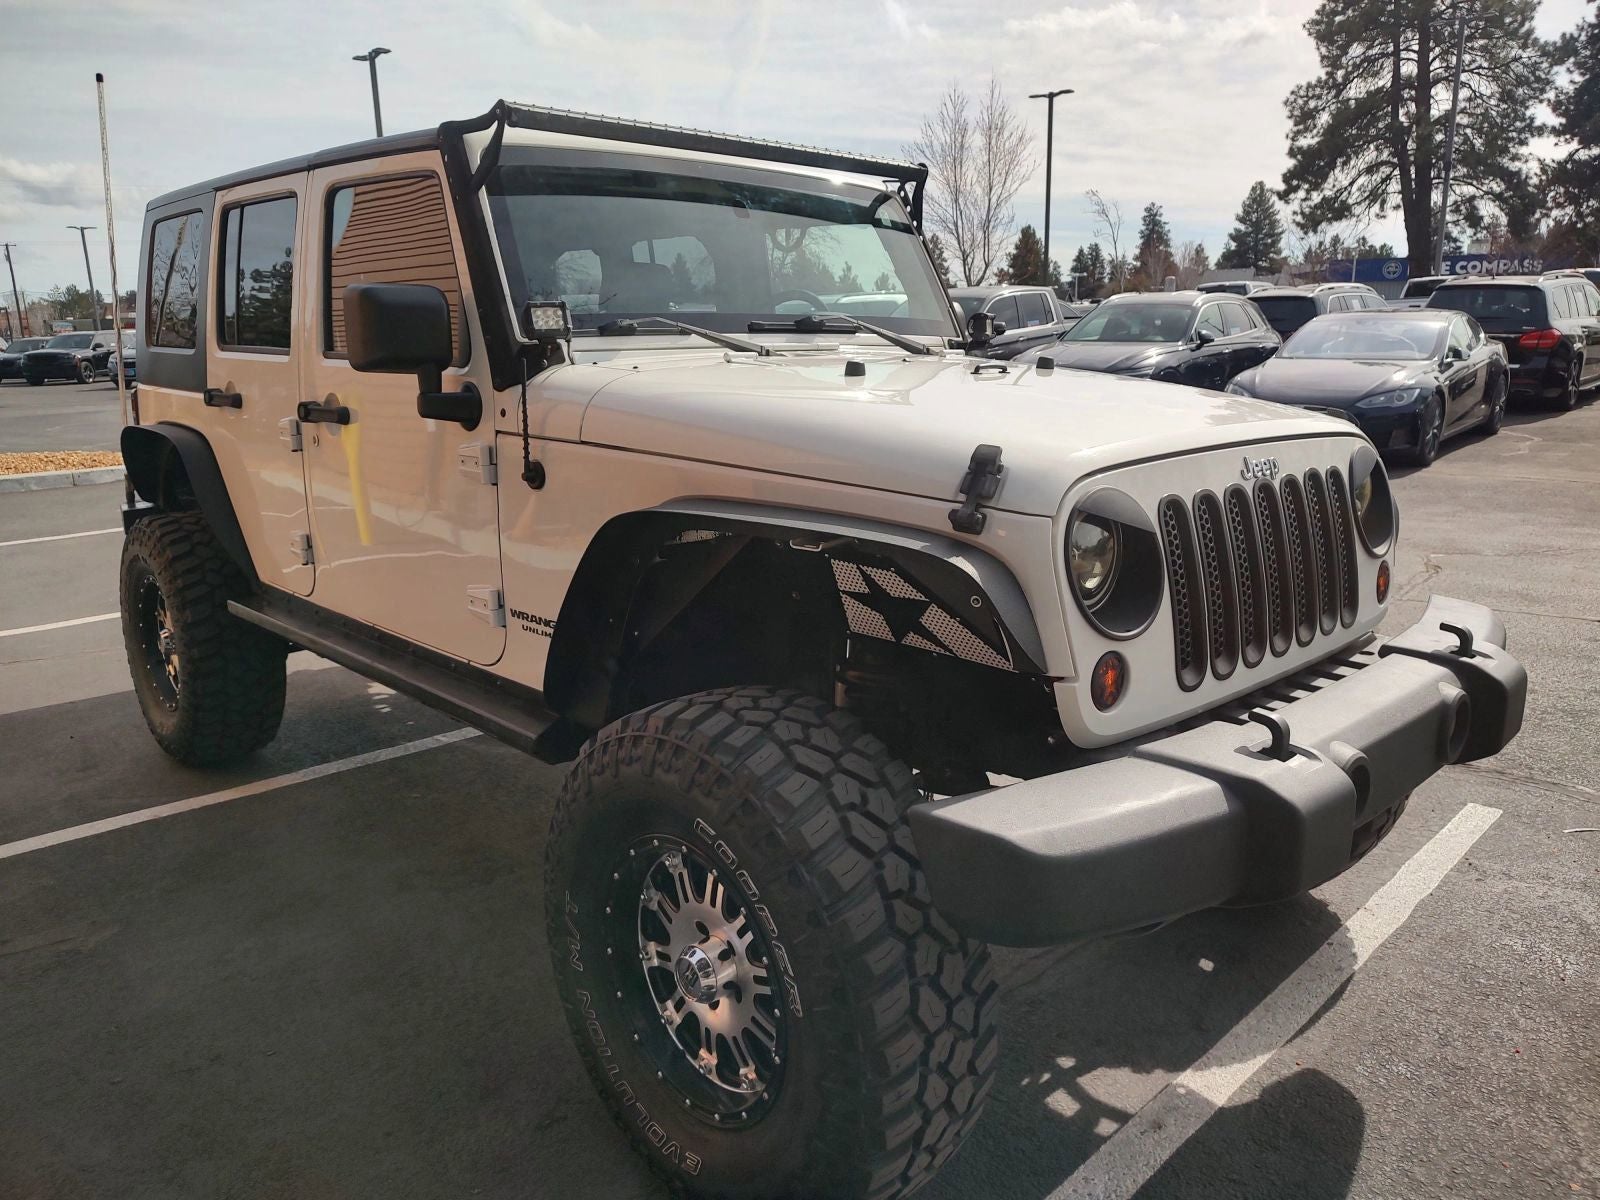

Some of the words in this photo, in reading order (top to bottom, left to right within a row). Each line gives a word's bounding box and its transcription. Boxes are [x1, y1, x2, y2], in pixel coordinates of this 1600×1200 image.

[1455, 258, 1543, 275] COMPASS
[1241, 456, 1279, 481] Jeep
[693, 817, 803, 1017] COOPER
[576, 989, 702, 1176] EVOLUTION
